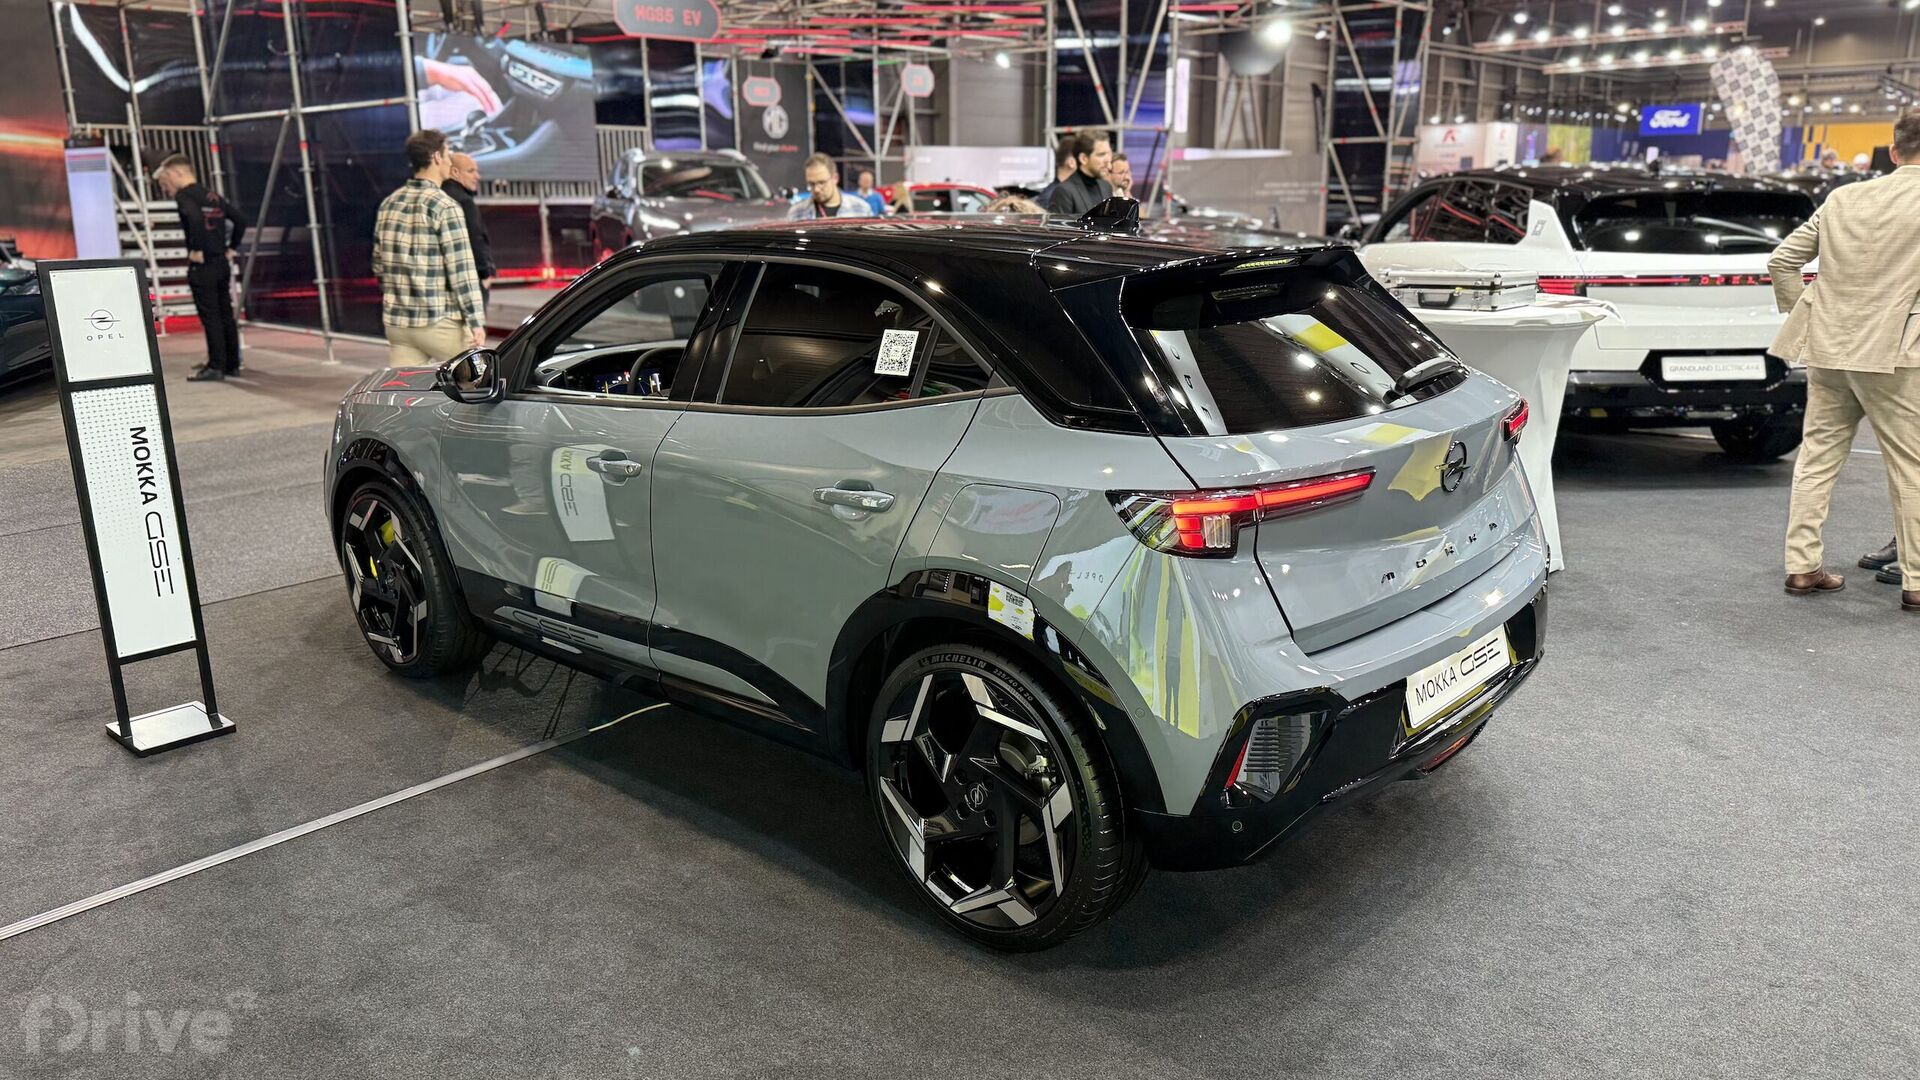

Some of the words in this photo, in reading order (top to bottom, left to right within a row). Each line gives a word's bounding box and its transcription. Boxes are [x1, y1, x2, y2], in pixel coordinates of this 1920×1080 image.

[682, 9, 702, 27] EV
[1649, 109, 1691, 129] Ford
[1701, 275, 1757, 286] OPEL
[86, 333, 125, 342] OPEL
[1669, 364, 1714, 373] GRANDLAND
[129, 426, 158, 506] MOKKA
[144, 511, 174, 597] GSE
[1380, 522, 1498, 585] MOKKA
[512, 610, 605, 650] GSE
[931, 654, 987, 669] MICHELIN
[1415, 666, 1458, 706] MOKKA
[1459, 637, 1501, 677] GSE
